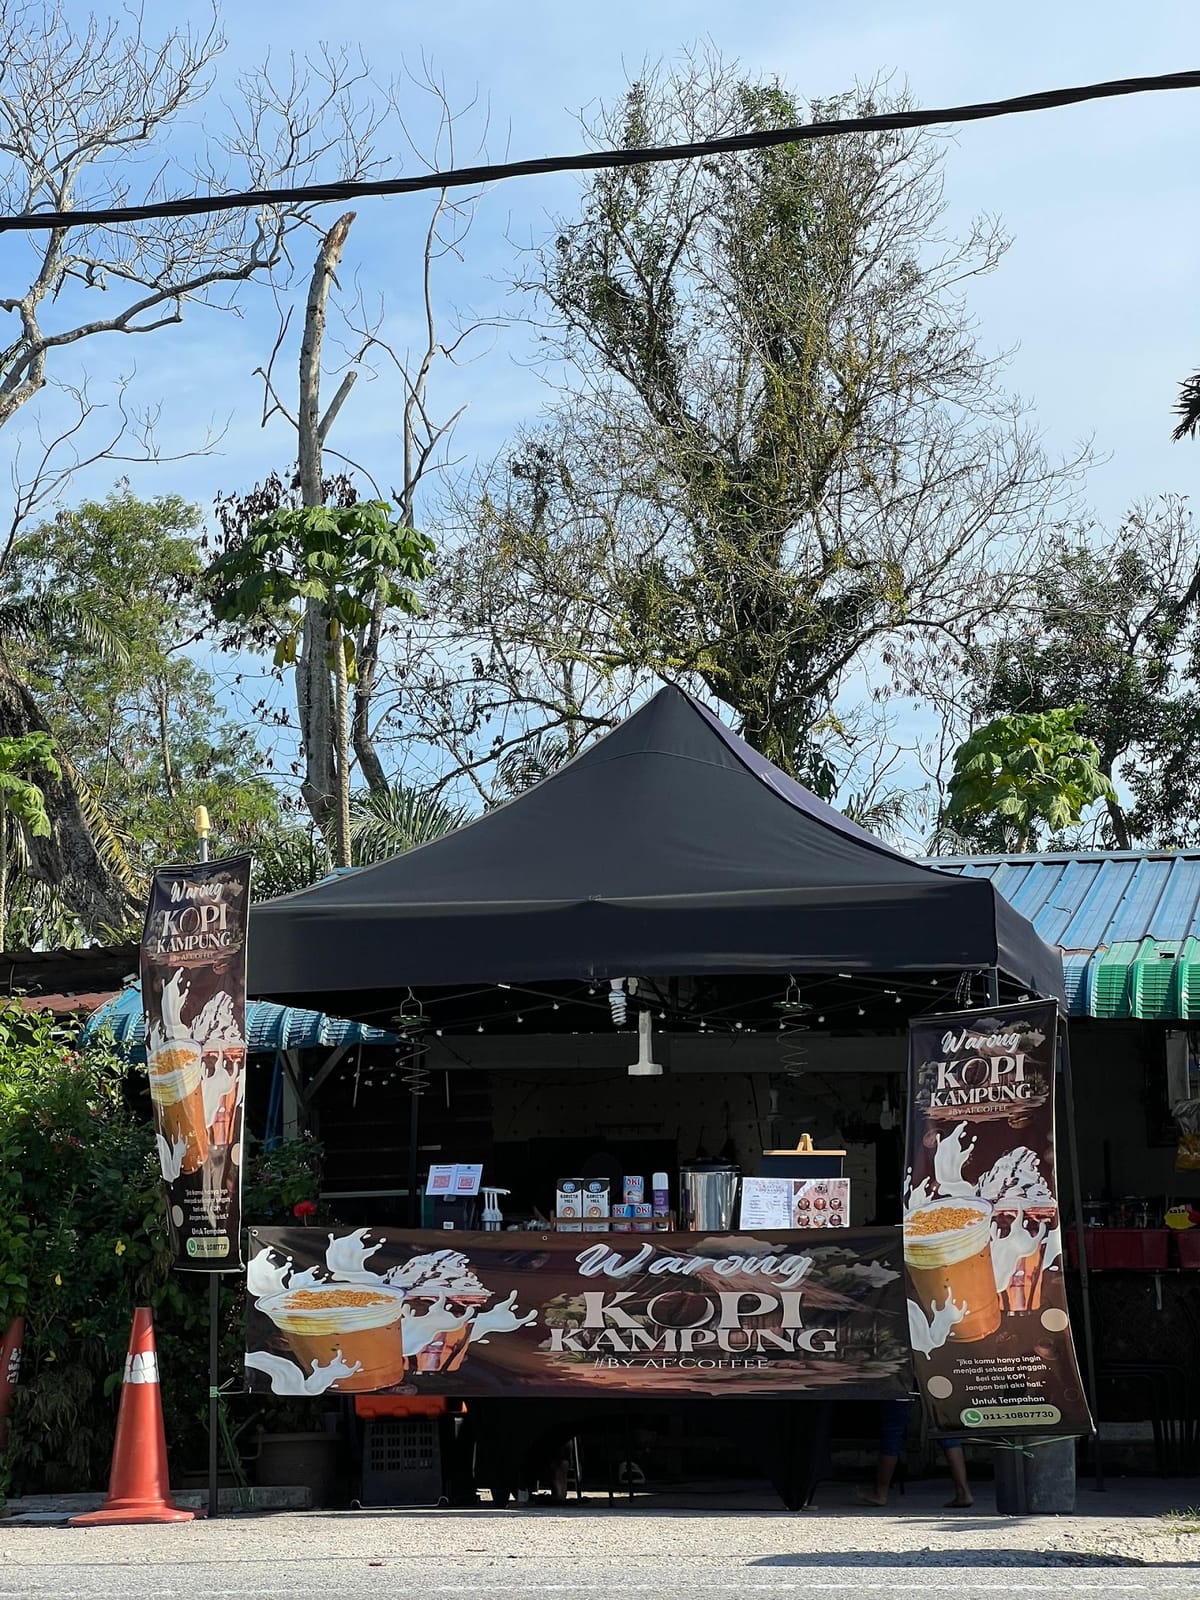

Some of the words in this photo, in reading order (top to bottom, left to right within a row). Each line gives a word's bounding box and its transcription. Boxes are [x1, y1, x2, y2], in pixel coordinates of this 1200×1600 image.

[162, 903, 227, 937] KOPI
[157, 931, 231, 954] KAMPUNG
[937, 1053, 1025, 1090] KOPI
[930, 1083, 1031, 1107] KAMPUNG
[575, 1242, 813, 1289] Warong
[583, 1291, 803, 1329] KOPI
[550, 1328, 838, 1353] KAMPUNG
[953, 1367, 983, 1375] menjadi
[985, 1365, 1015, 1373] sekadar
[1016, 1363, 1047, 1372] singgah
[996, 1357, 1021, 1365] hanya
[971, 1397, 998, 1406] Untuk
[998, 1395, 1045, 1404] Tempahan
[982, 1411, 1054, 1420] 011-10807730
